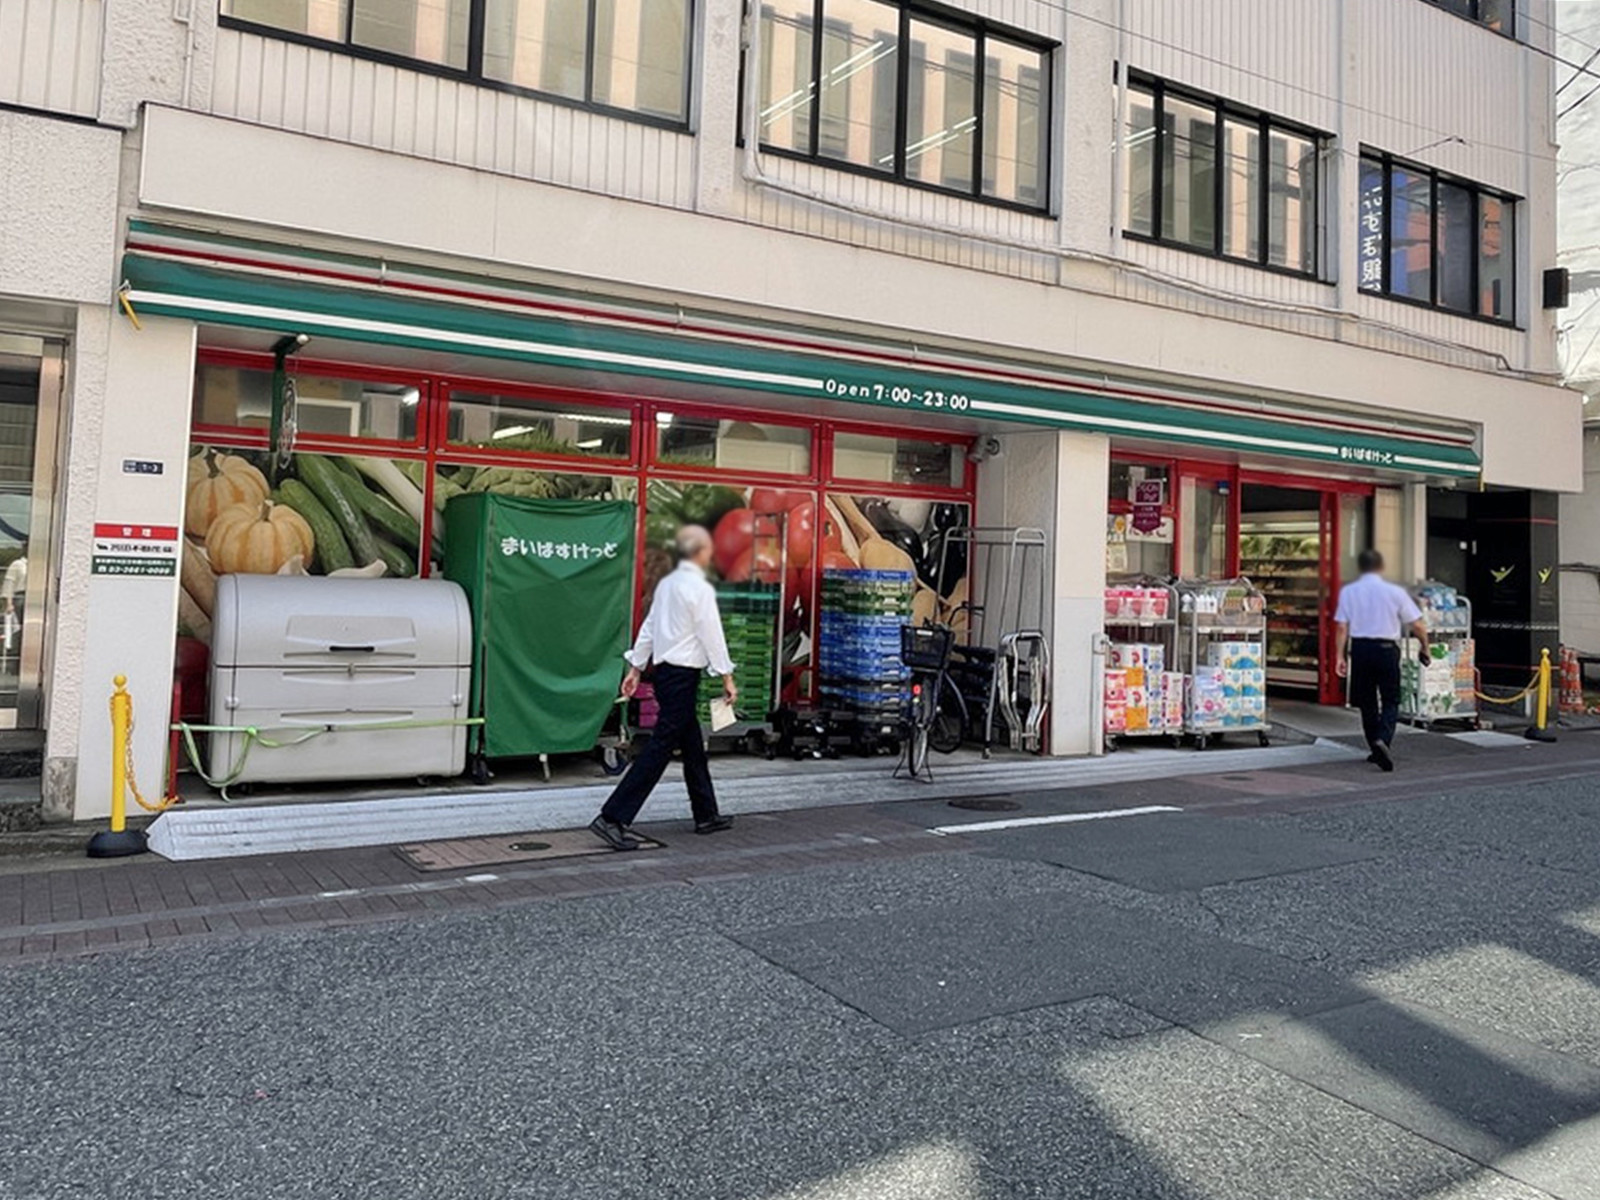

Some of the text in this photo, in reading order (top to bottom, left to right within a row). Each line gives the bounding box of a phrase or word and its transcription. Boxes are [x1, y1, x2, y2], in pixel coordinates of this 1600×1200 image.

[826, 379, 870, 396] Open
[501, 536, 618, 559] まいばすけっと
